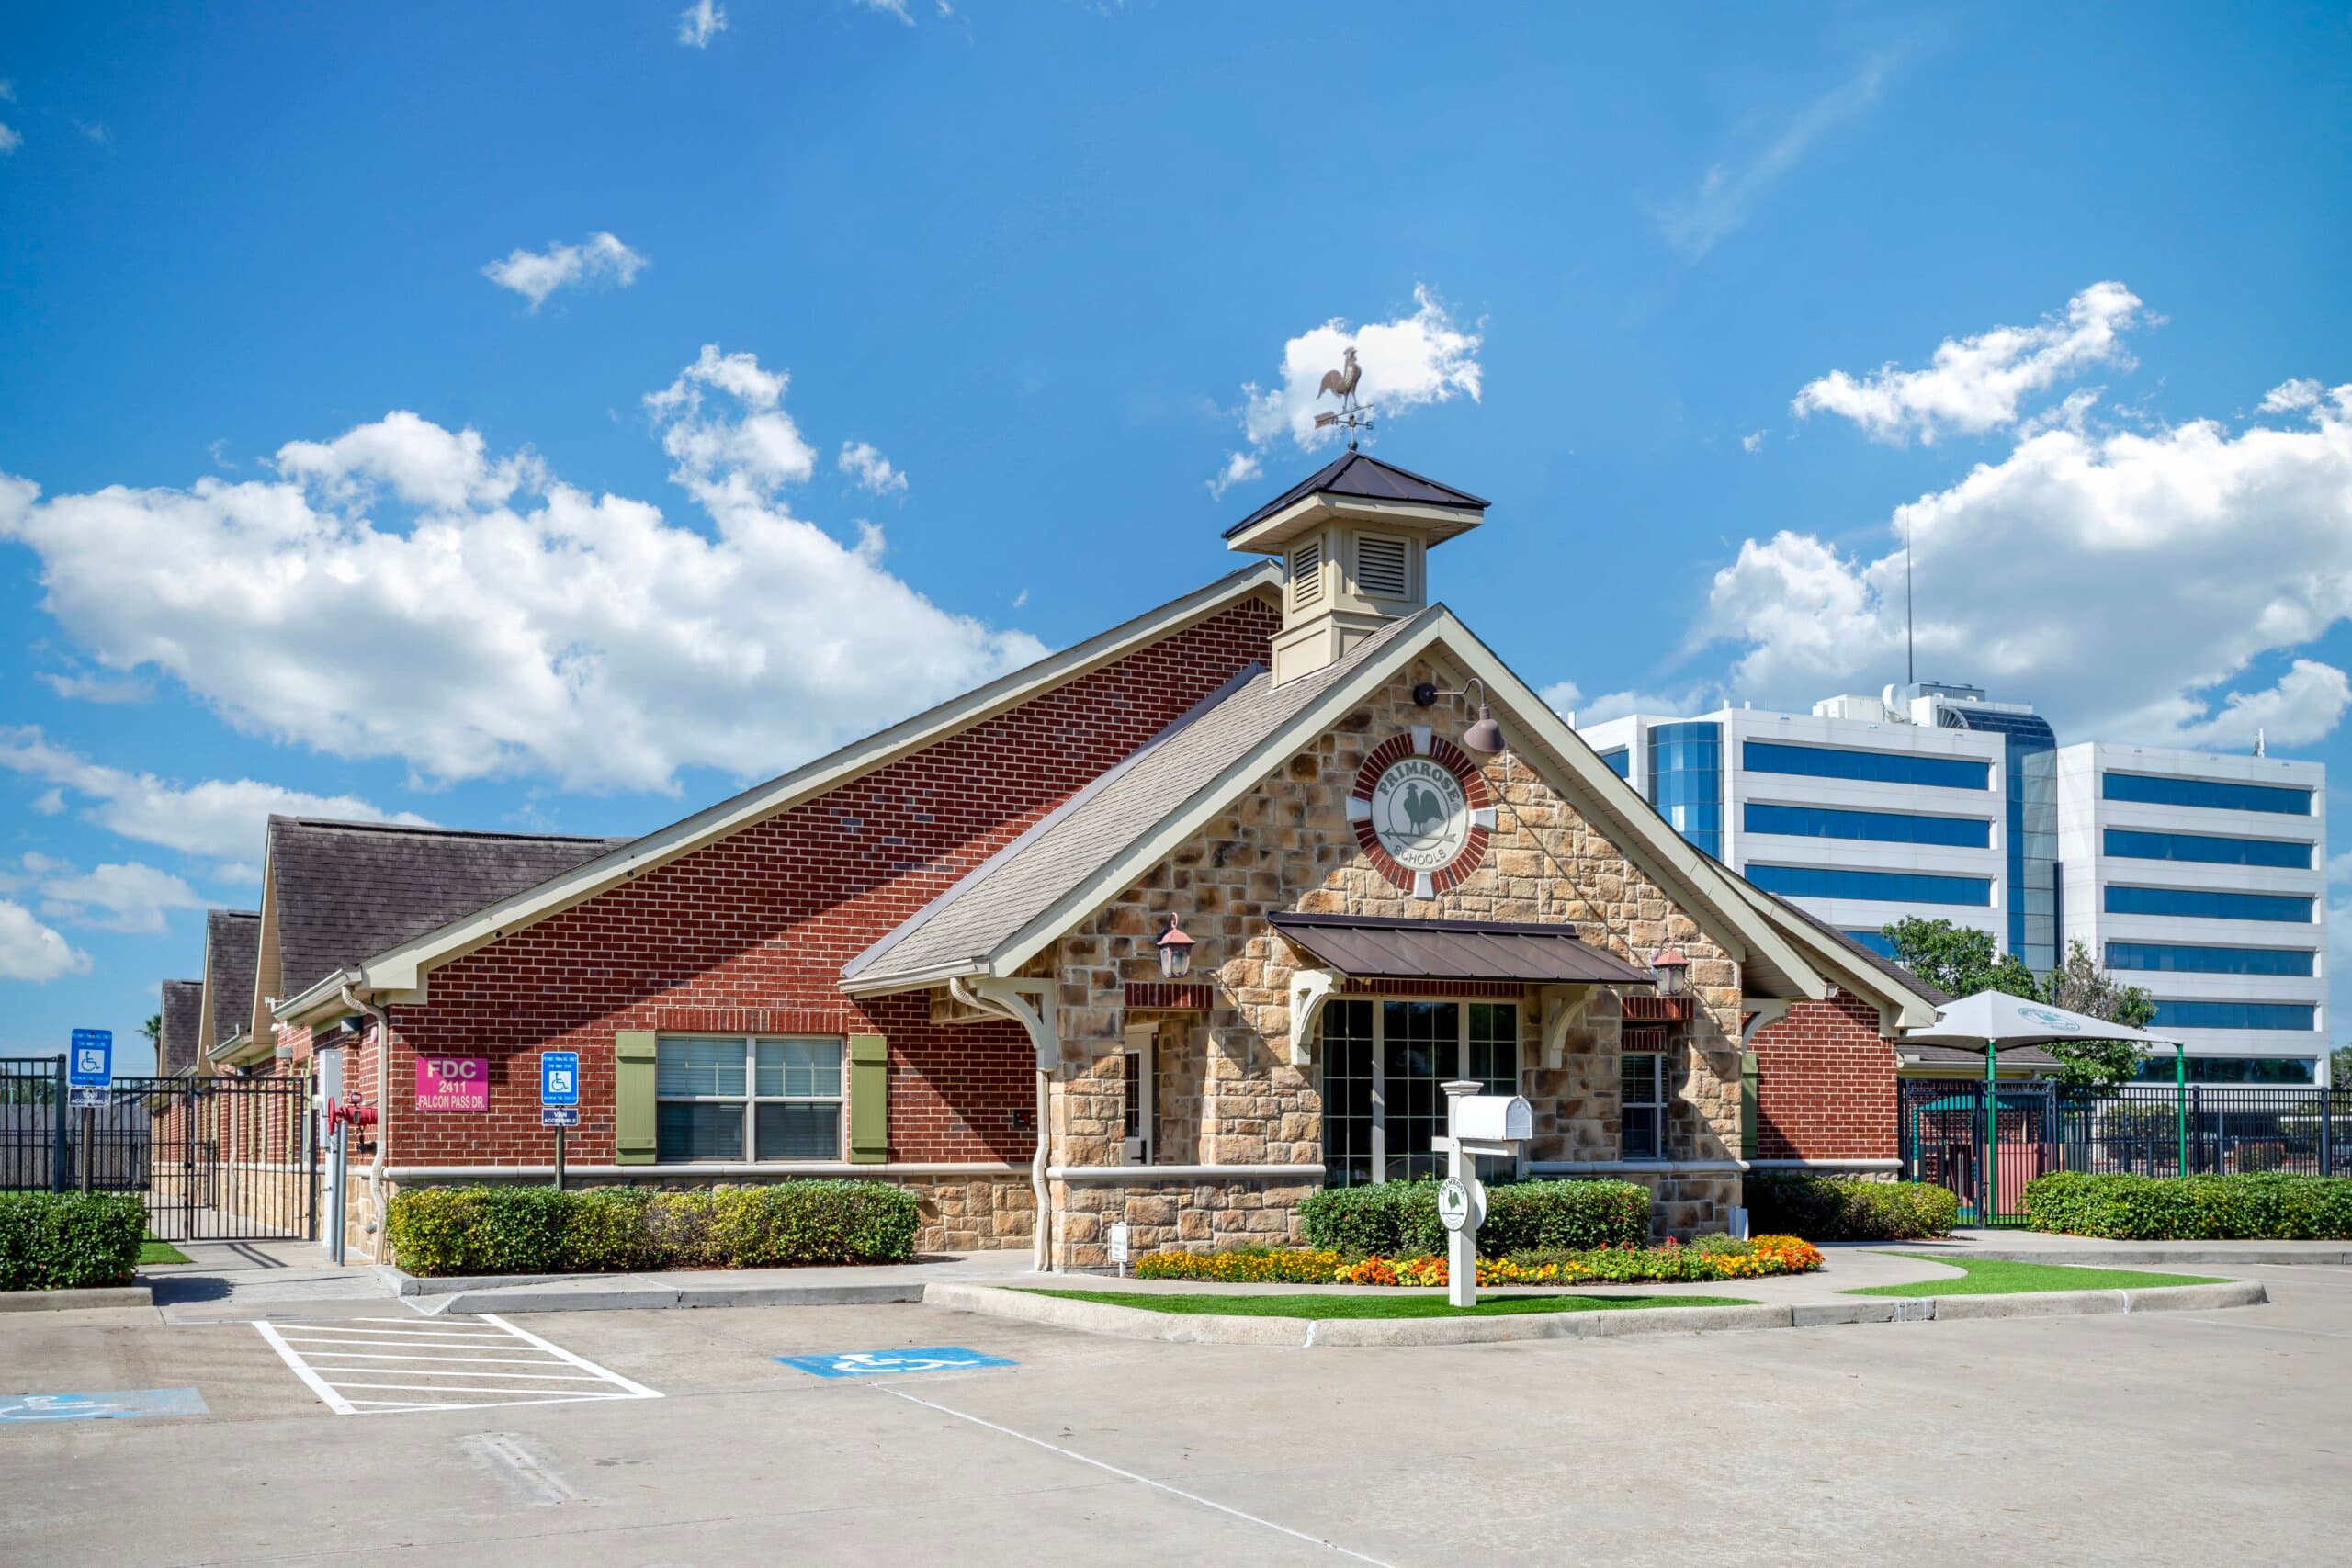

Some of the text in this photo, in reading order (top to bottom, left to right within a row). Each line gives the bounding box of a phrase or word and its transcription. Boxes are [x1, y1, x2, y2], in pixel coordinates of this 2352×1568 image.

[1378, 761, 1460, 802] PRIMROSE
[1394, 845, 1446, 865] SCHOOLS
[427, 1060, 476, 1079] FDC
[439, 1080, 467, 1093] 2411
[418, 1094, 485, 1109] FALCON PASS DR.
